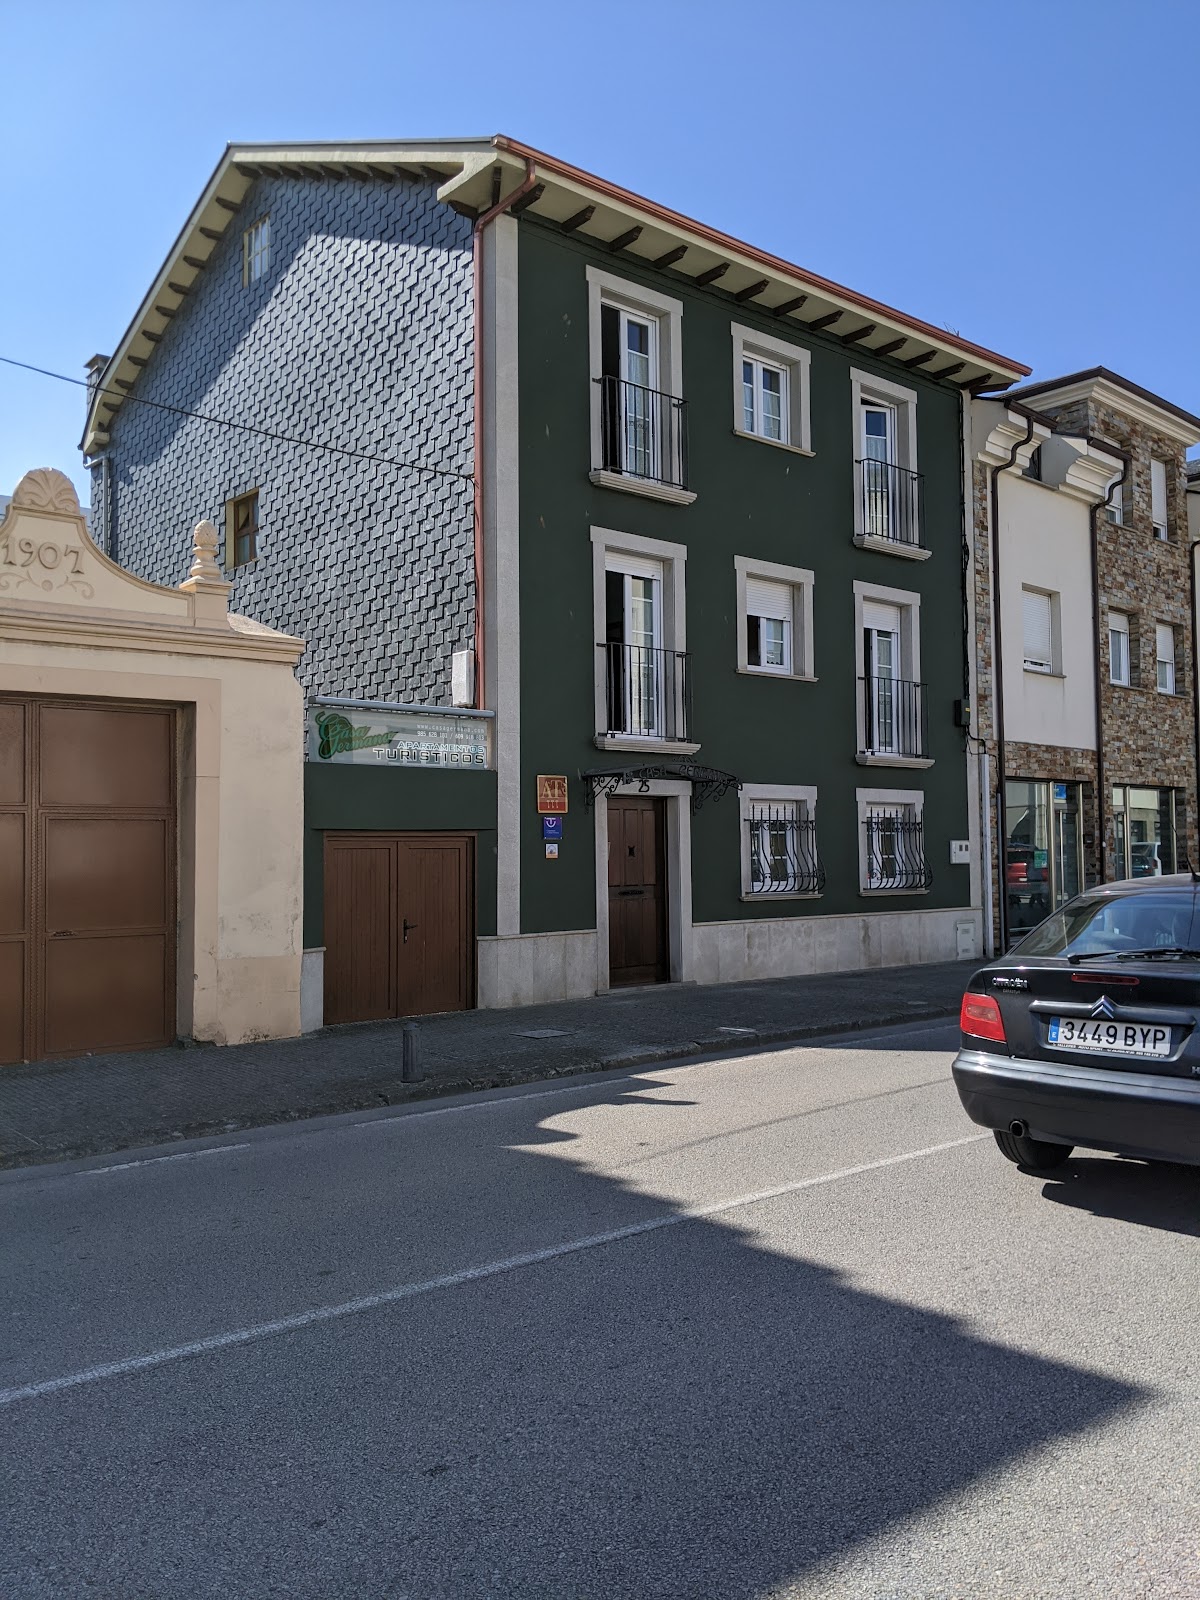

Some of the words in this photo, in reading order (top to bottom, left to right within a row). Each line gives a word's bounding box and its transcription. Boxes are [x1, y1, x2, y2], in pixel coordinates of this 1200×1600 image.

[2, 537, 85, 575] 1907
[372, 747, 486, 765] TURISTICOS
[396, 740, 485, 754] APARTAMENTOS
[638, 779, 650, 792] 25
[1063, 1021, 1118, 1045] 3449
[1124, 1026, 1166, 1050] BYP
